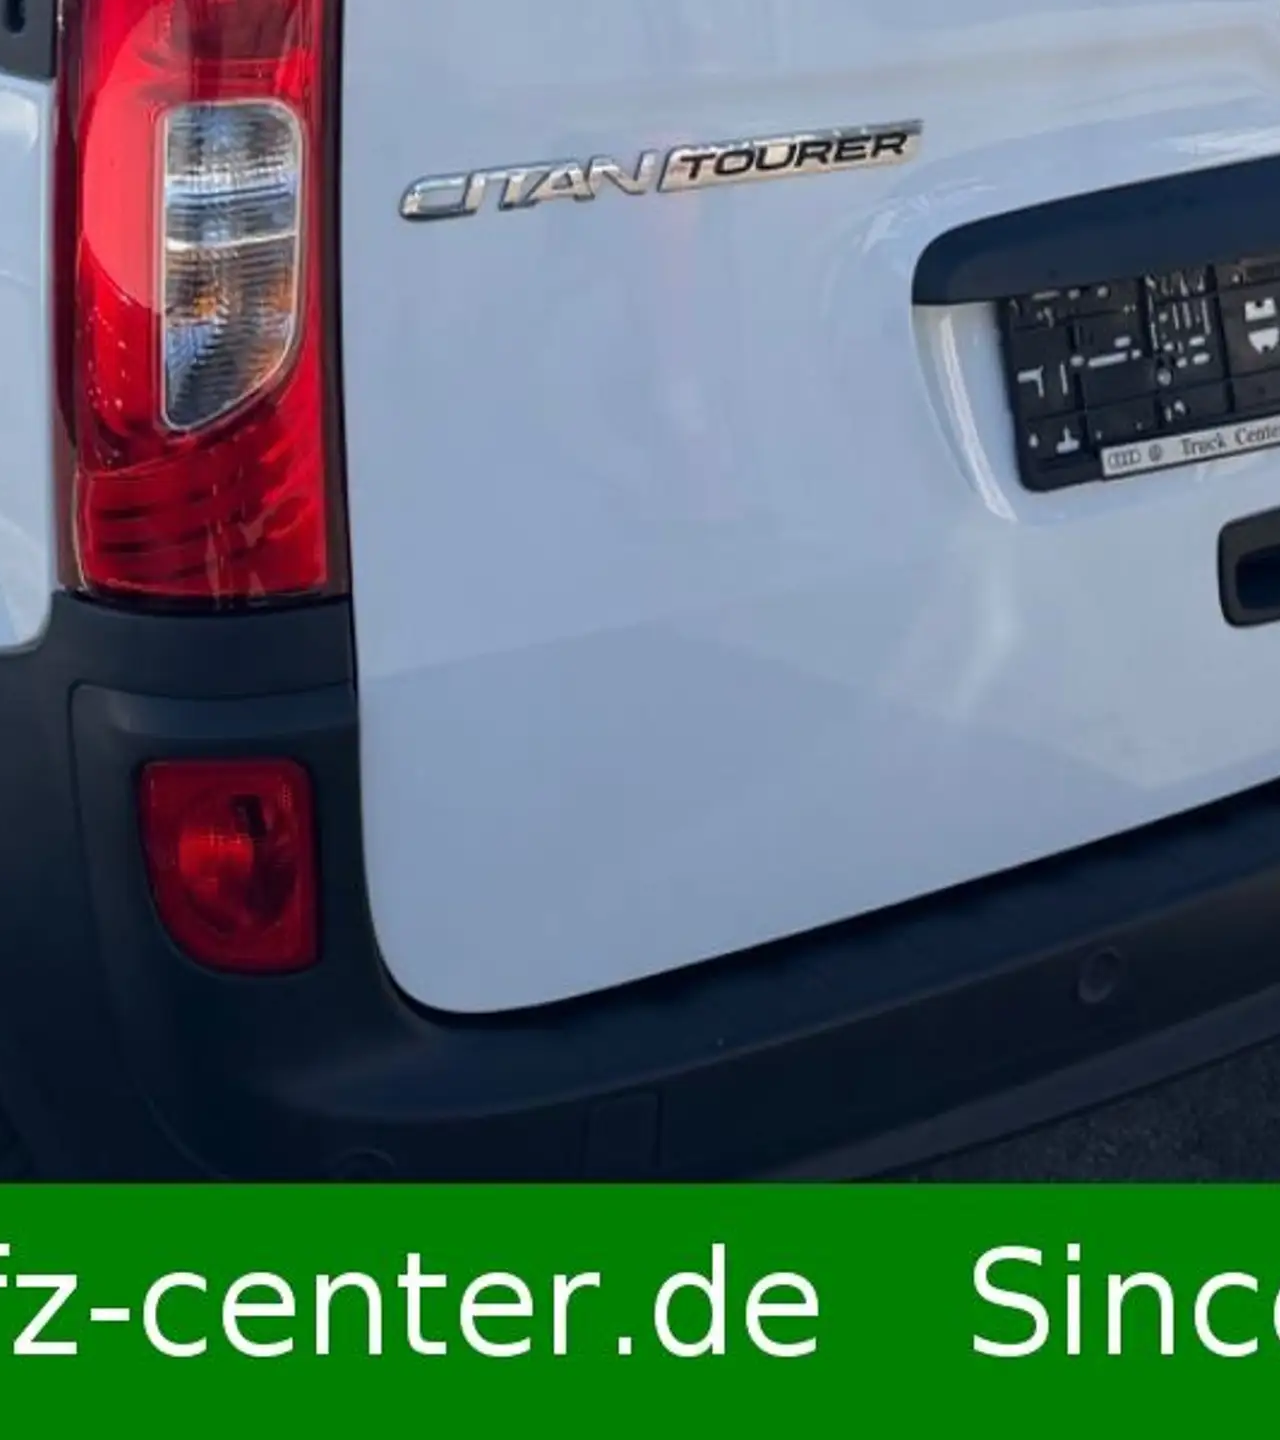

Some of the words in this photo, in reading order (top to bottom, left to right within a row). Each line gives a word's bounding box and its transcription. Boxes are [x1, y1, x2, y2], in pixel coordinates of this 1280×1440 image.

[399, 148, 658, 221] CITAN
[679, 131, 909, 180] TOURER
[1180, 433, 1227, 458] Truck
